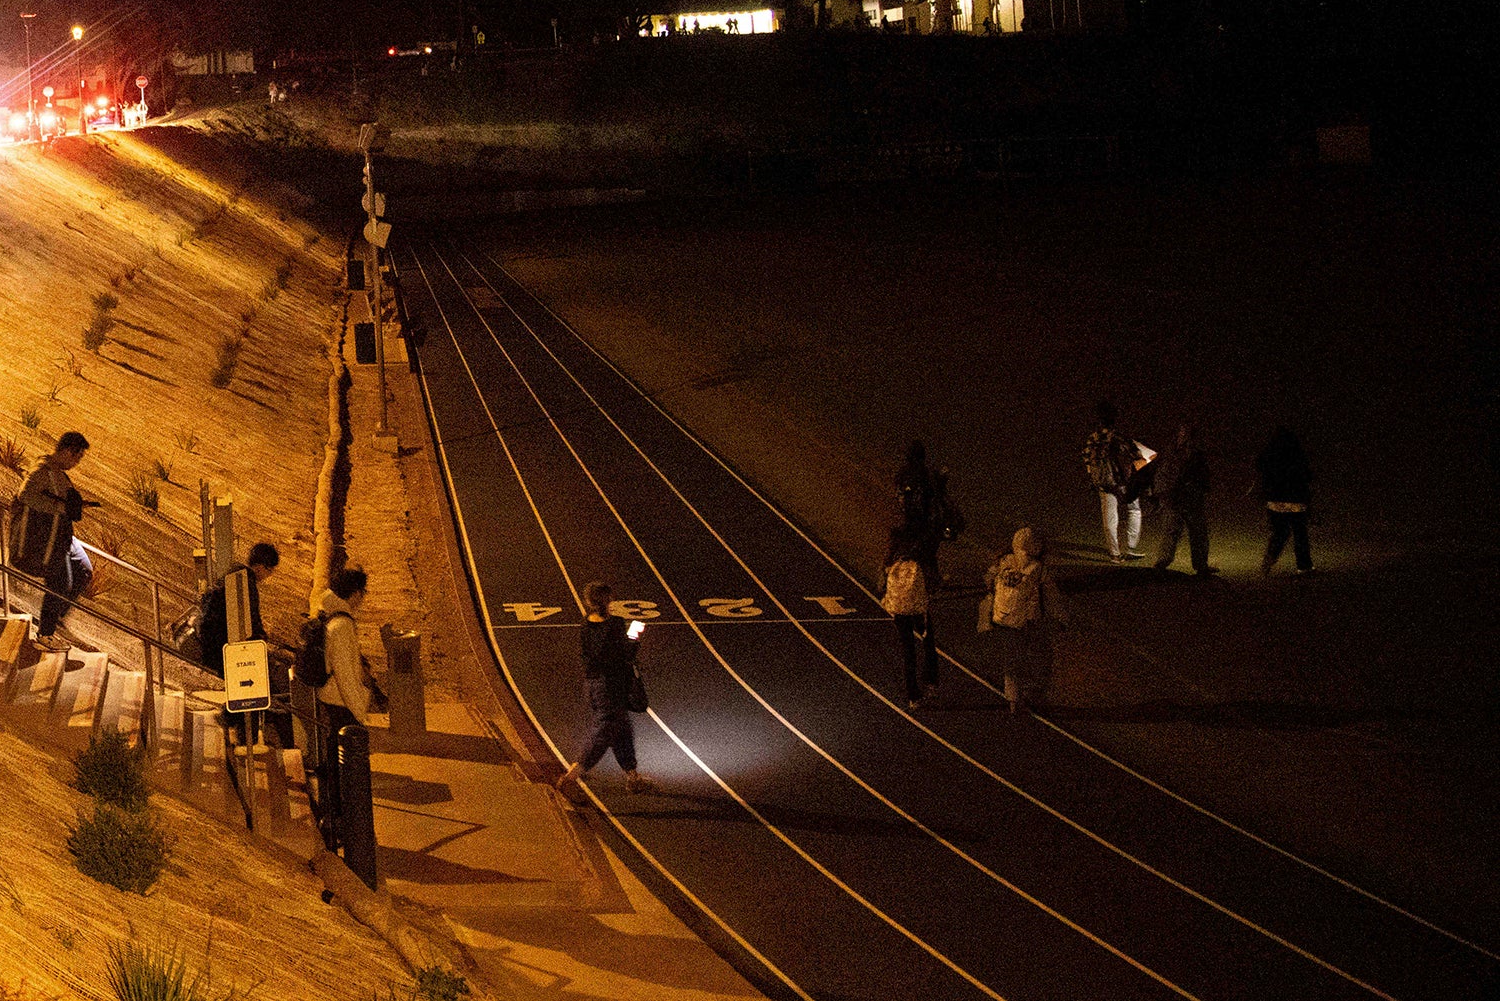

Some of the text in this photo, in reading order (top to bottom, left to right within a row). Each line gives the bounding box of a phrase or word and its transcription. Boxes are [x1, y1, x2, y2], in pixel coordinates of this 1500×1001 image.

[502, 596, 856, 622] 1 2 3 4
[236, 660, 256, 668] STAIRS
